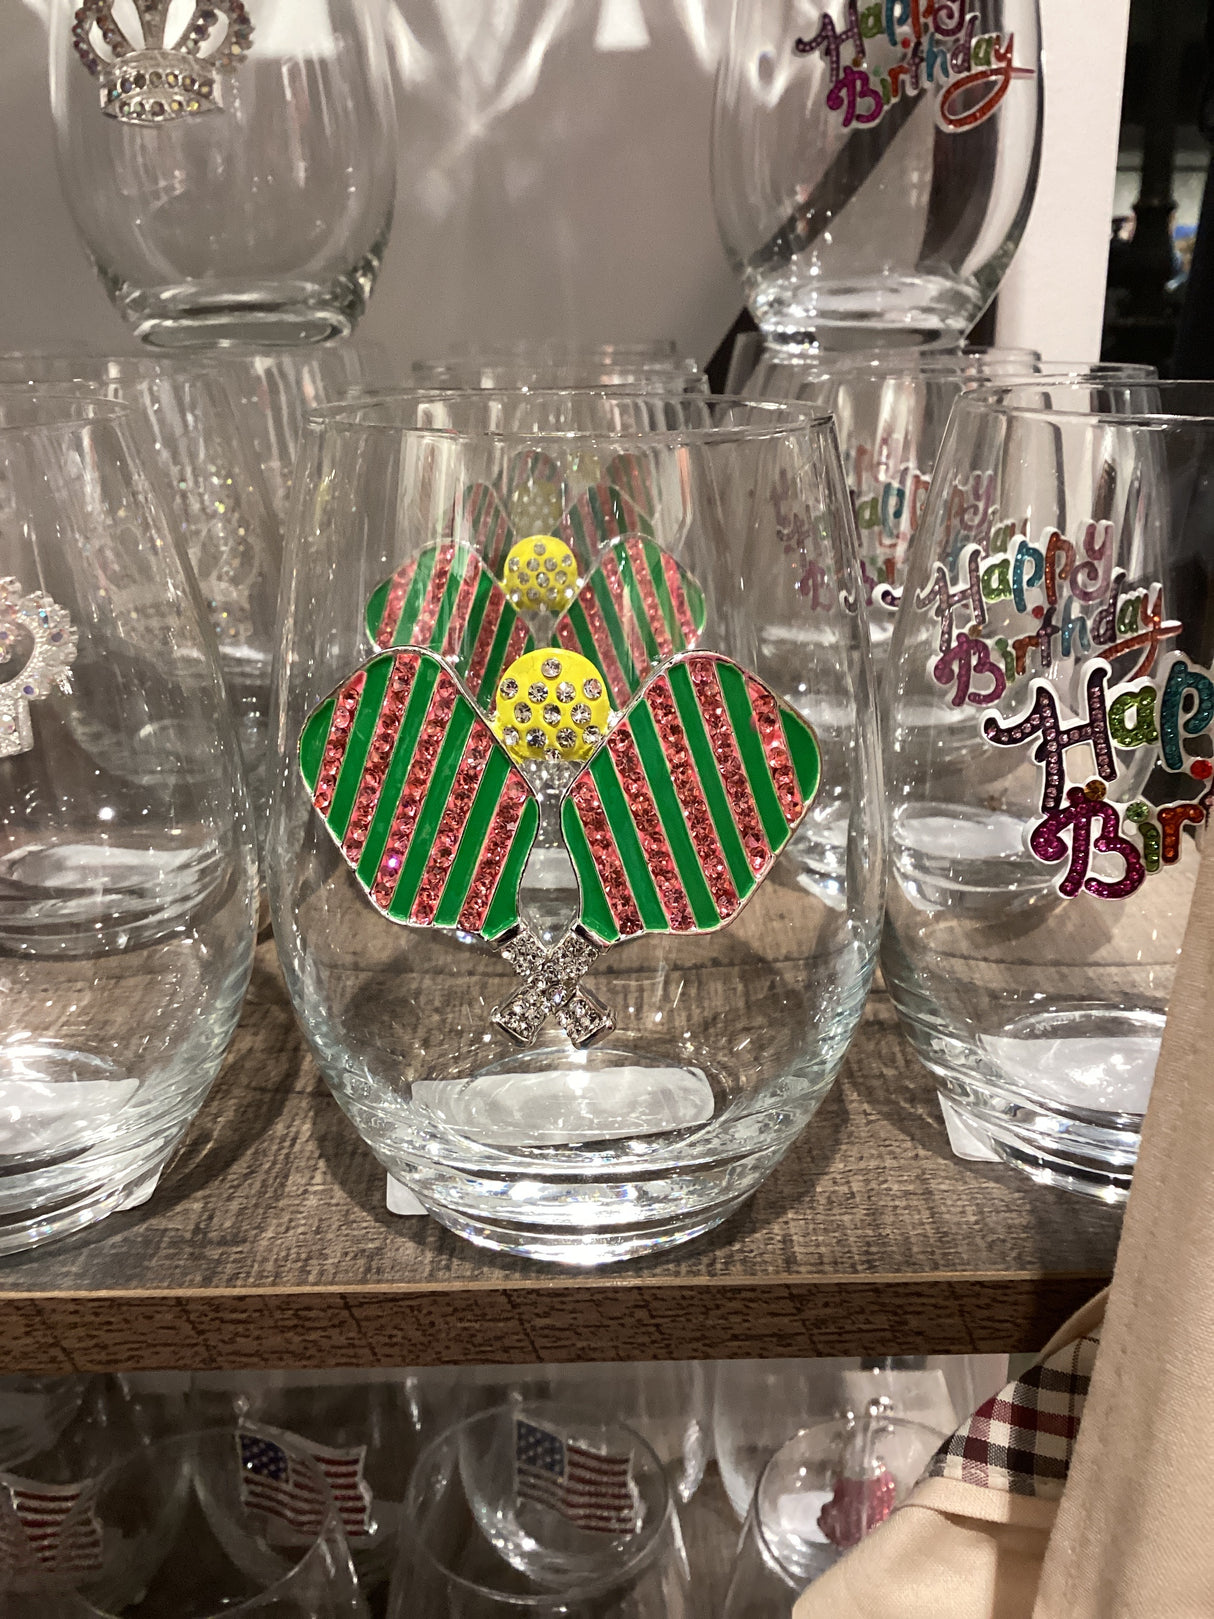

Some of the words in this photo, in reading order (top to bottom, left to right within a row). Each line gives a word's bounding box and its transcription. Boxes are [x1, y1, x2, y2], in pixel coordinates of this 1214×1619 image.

[826, 13, 1035, 128] Birthday
[915, 521, 1114, 653] Happy
[933, 570, 1184, 707] Birthday
[1030, 785, 1214, 899] Bir
